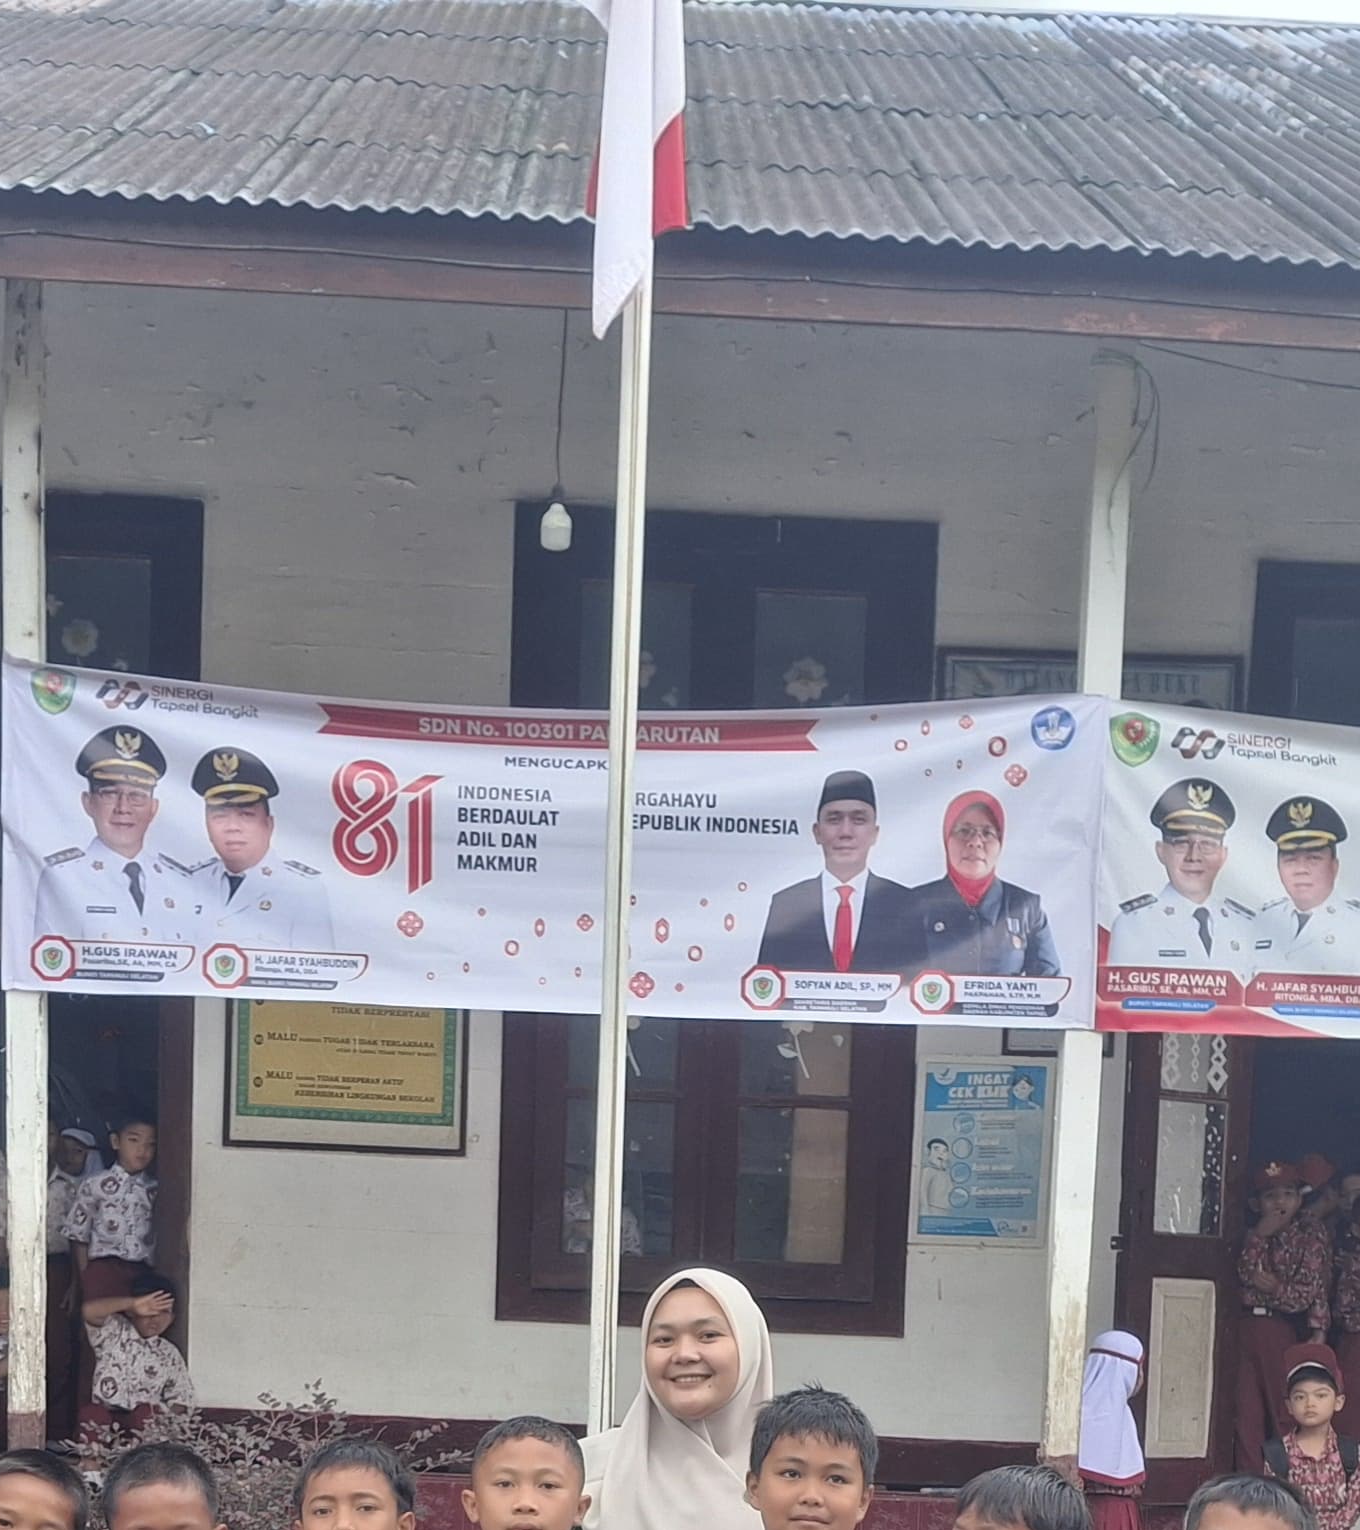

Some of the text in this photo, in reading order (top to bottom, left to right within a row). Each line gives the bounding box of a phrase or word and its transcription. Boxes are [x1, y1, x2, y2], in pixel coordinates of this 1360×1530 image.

[151, 685, 214, 701] SINERGI
[152, 699, 259, 720] Tapsel Bangkit
[418, 716, 720, 744] SDN No. 100301 PAARUTAN
[1227, 733, 1291, 749] SINERGI
[504, 755, 609, 770] MENGUCAPK
[1229, 745, 1338, 767] Tapsel Bangkit
[457, 784, 552, 803] INDONESIA
[635, 791, 717, 809] RGAHAYU
[457, 807, 560, 828] BERDAULAT
[632, 813, 800, 836] EPUBLIK INDONESIA
[331, 758, 446, 896] 81
[457, 830, 538, 850] ADIL DAN
[457, 853, 538, 874] MAKMUR
[82, 946, 178, 960] H.GUS IRAWAN
[266, 956, 296, 966] JAFAR
[795, 980, 831, 989] SOFYAN
[964, 981, 1037, 992] EFRIDA YANTI
[1108, 971, 1228, 987] H. GUS IRAWAN
[1256, 981, 1268, 991] H.
[1271, 982, 1308, 992] JAFAR
[267, 1032, 298, 1042] MALU
[266, 1070, 293, 1080] MALU
[968, 1073, 1012, 1085] INGAT
[948, 1086, 974, 1098] CEK
